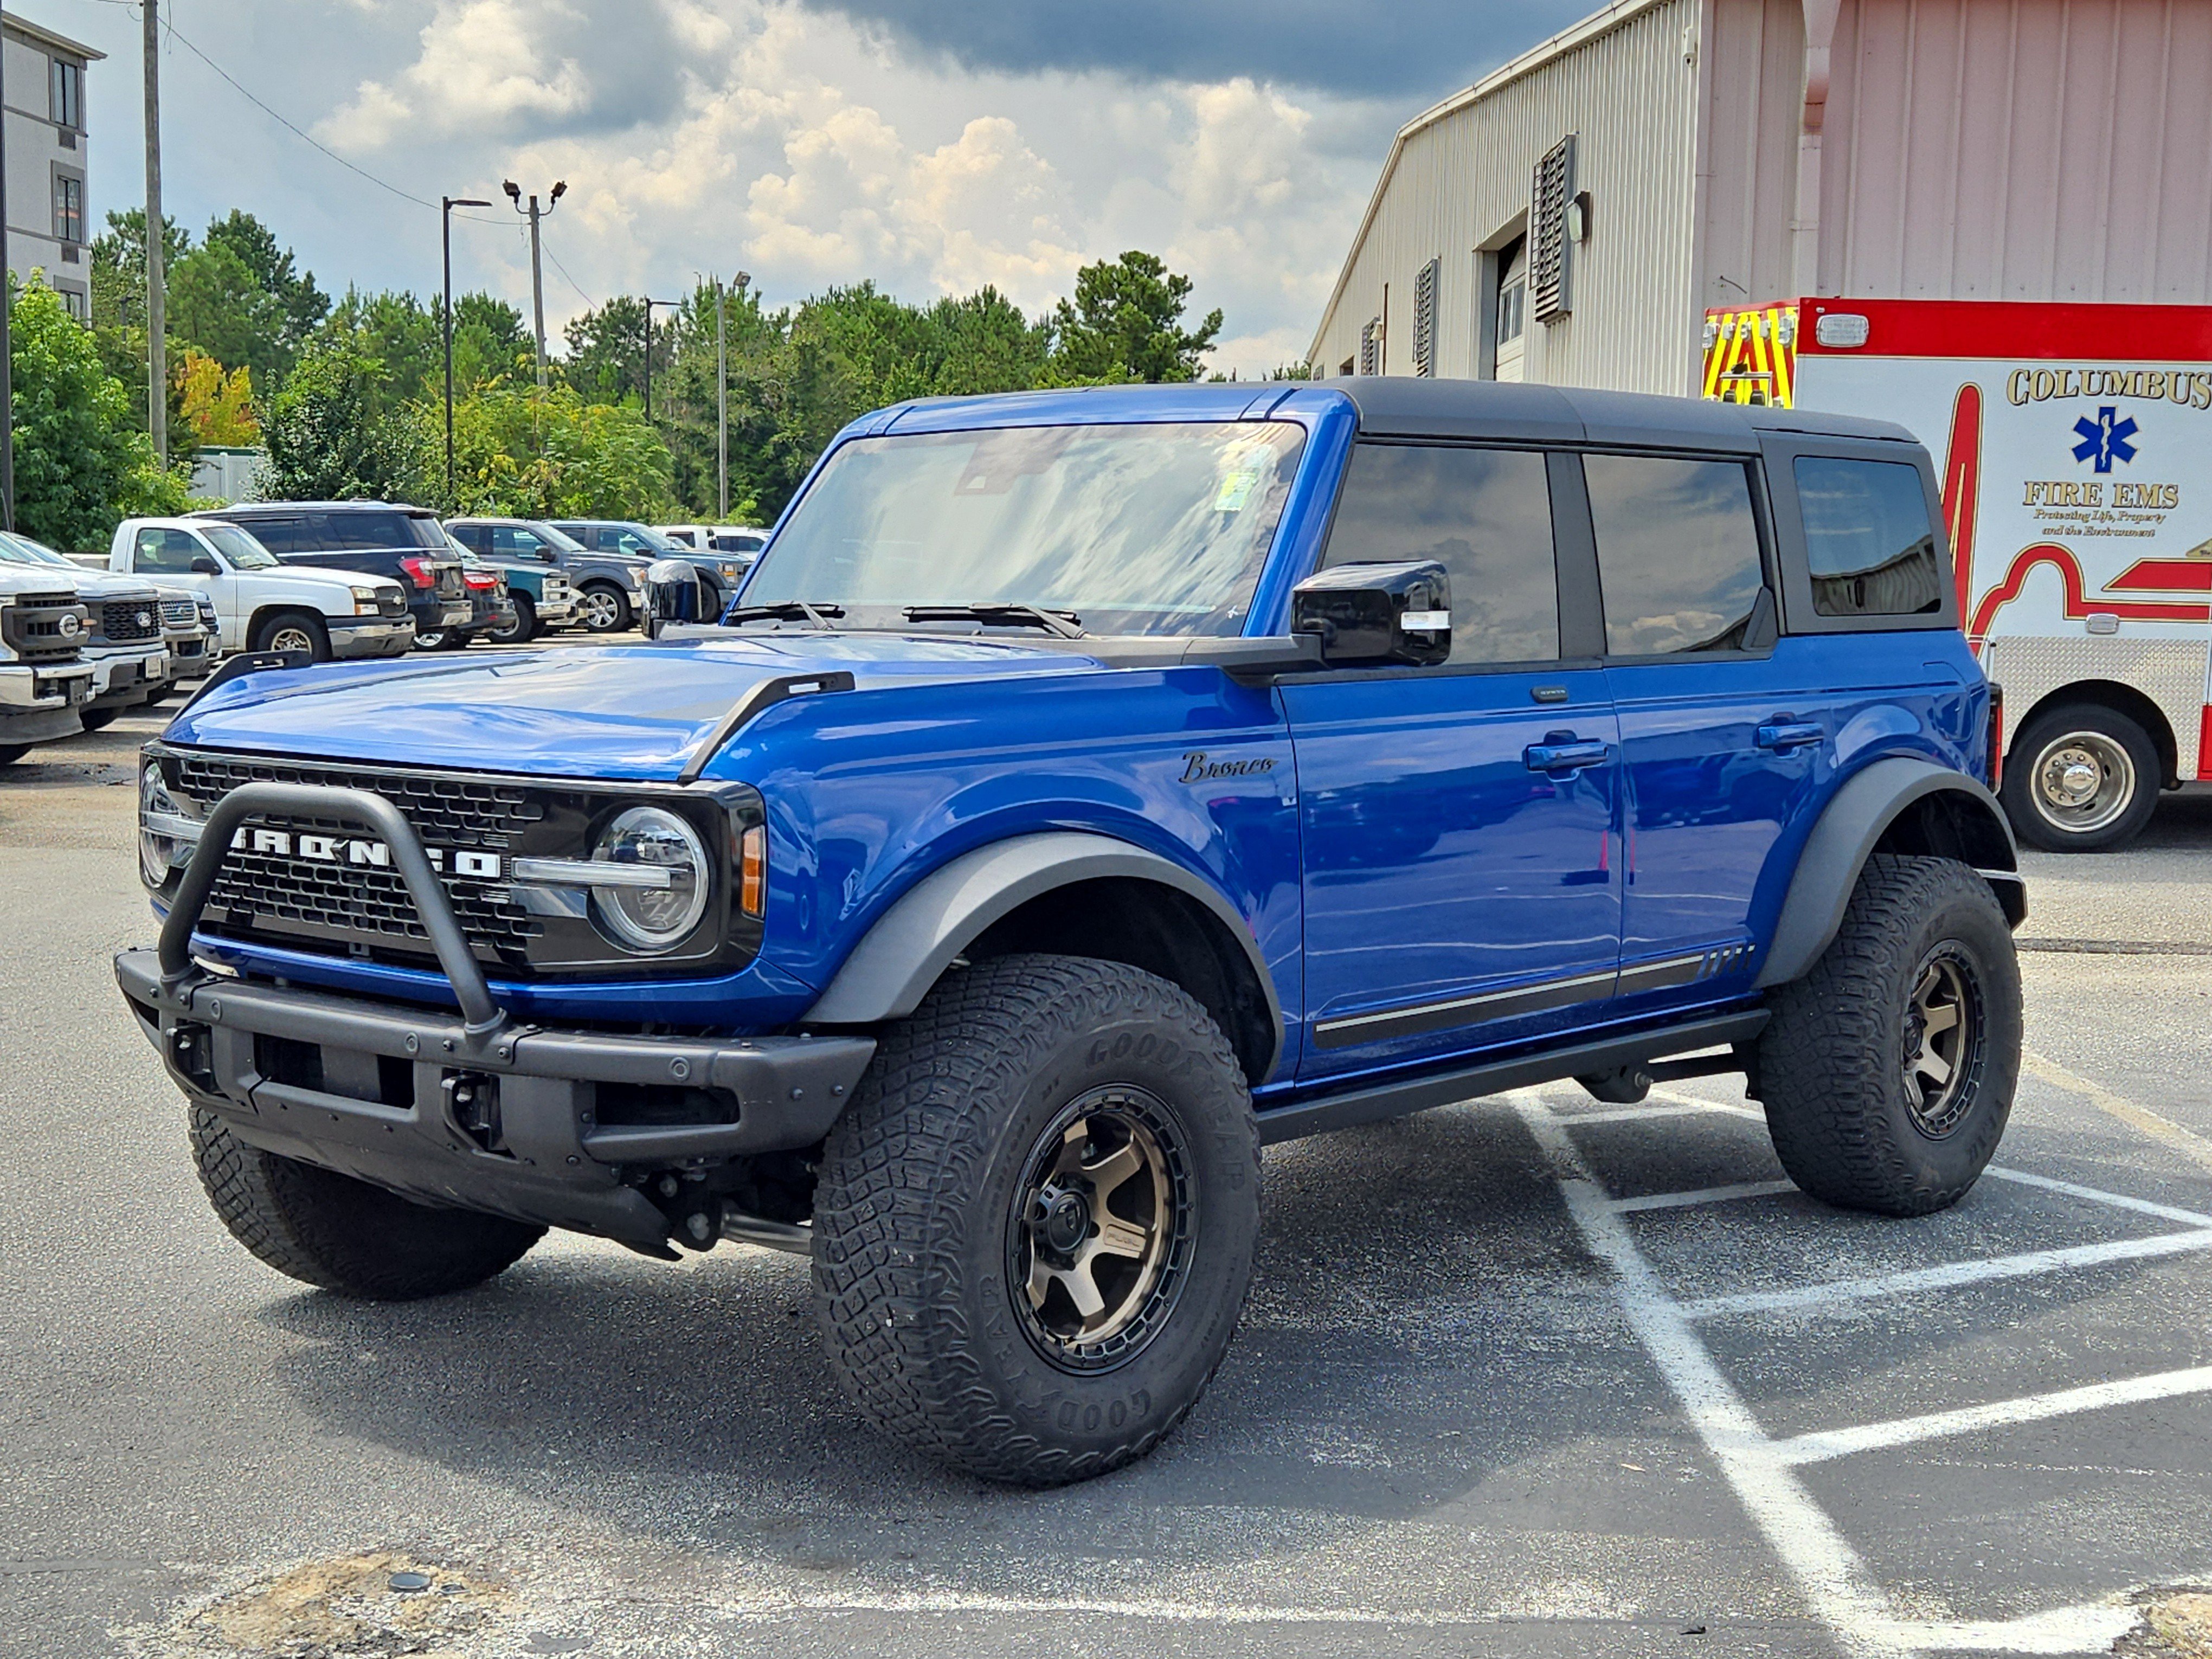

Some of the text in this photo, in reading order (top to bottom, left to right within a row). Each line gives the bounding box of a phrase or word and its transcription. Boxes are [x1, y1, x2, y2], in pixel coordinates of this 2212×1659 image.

[2007, 369, 2212, 409] COLUMBUS
[2022, 480, 2178, 510] FIRE EMS
[2033, 509, 2090, 523] Protecting
[2117, 511, 2166, 525] Property
[2042, 525, 2063, 536] and
[2065, 526, 2082, 536] the
[1178, 751, 1278, 784] Bronco
